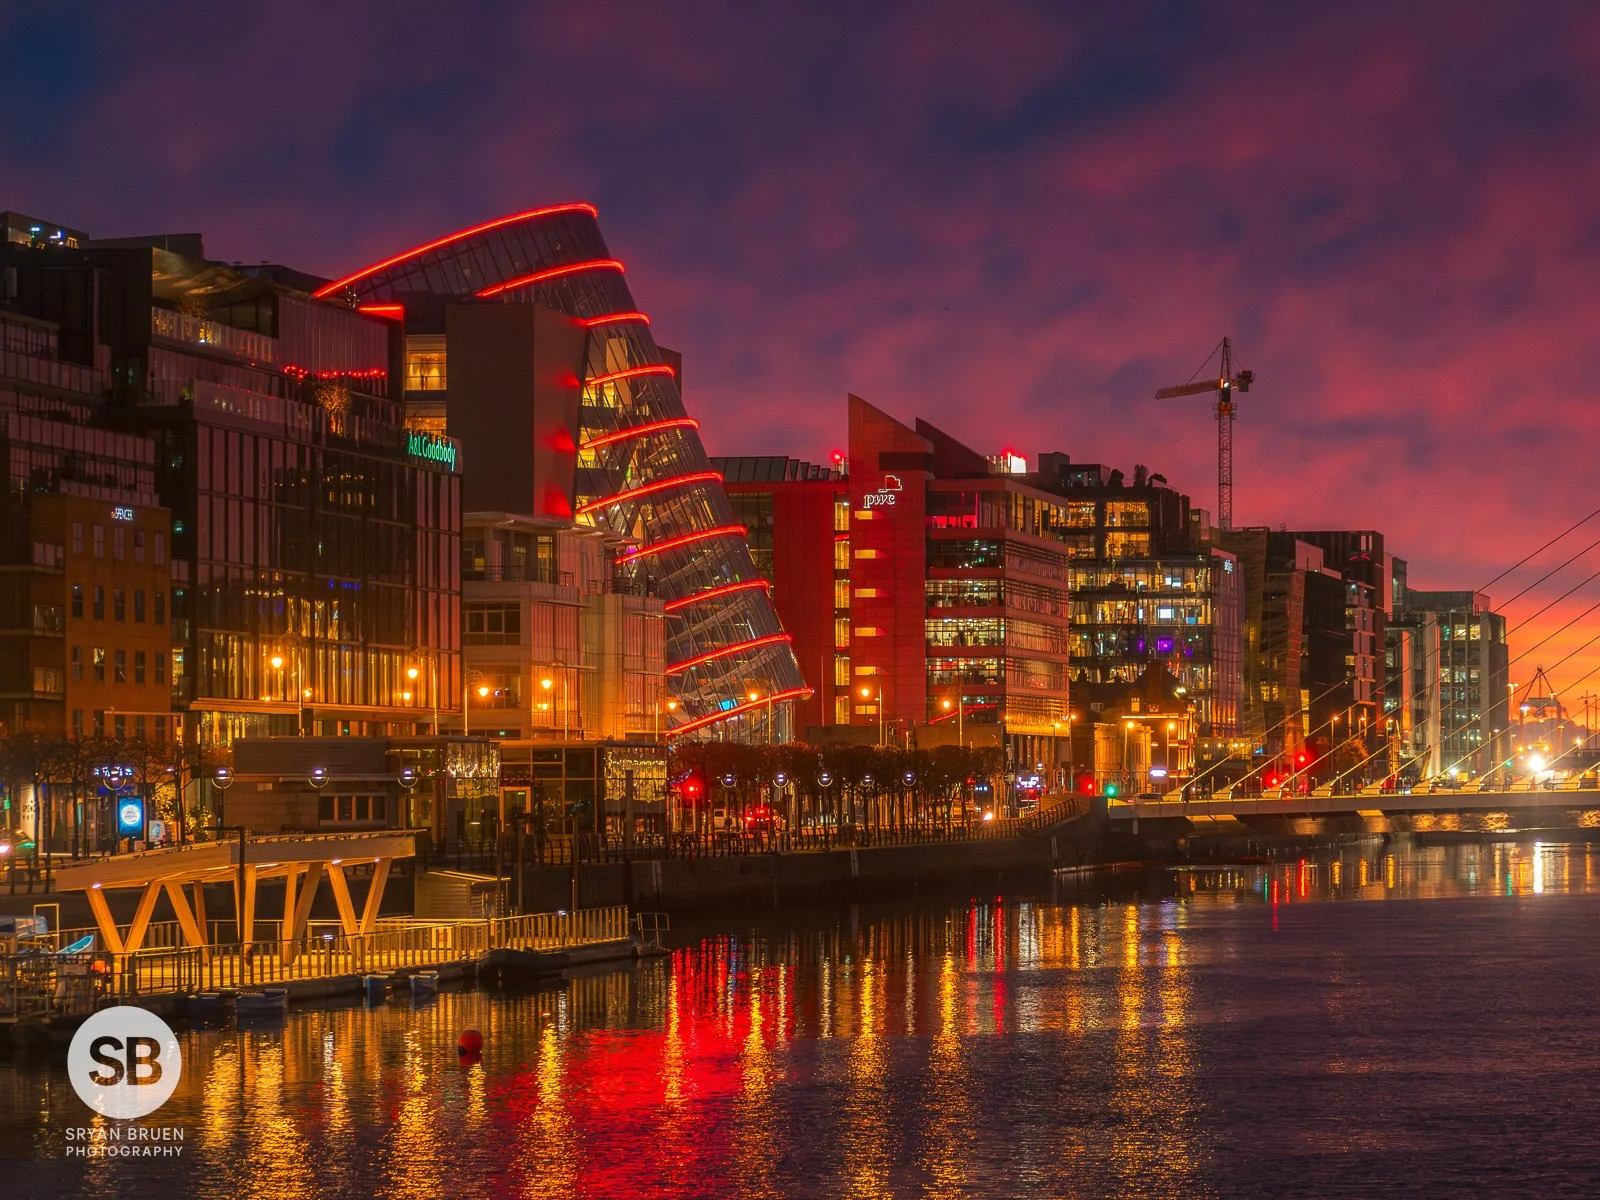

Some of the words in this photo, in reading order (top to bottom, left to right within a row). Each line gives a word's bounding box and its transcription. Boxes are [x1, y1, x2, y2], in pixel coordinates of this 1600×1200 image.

[408, 432, 421, 456] A&L
[422, 436, 456, 472] Goodbody
[863, 494, 896, 508] pwc
